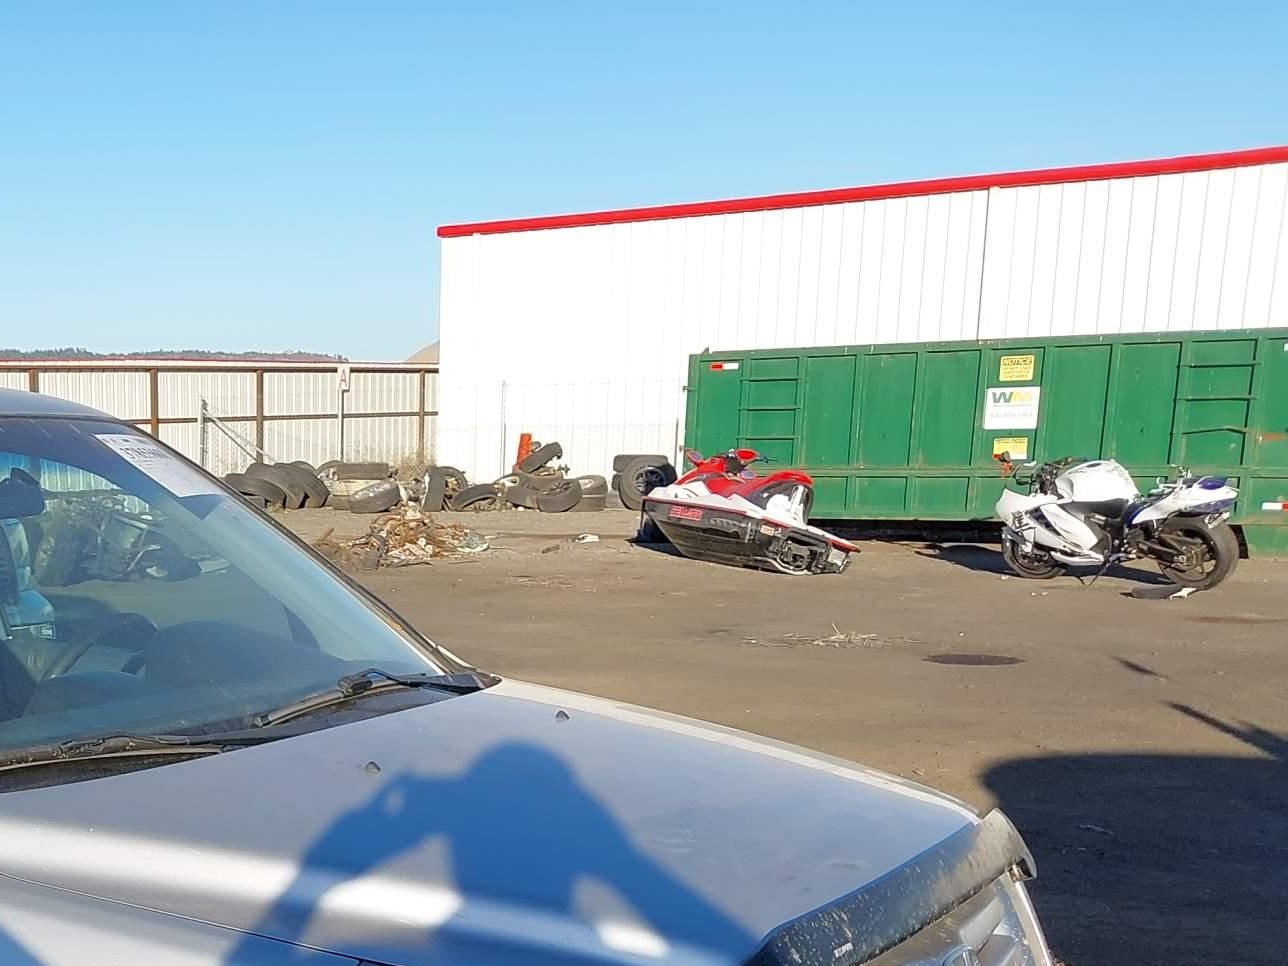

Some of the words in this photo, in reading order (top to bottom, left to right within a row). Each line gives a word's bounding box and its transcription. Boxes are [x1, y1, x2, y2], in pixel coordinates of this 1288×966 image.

[1002, 357, 1033, 366] NOTICE
[338, 369, 348, 388] A
[992, 391, 1032, 404] WM
